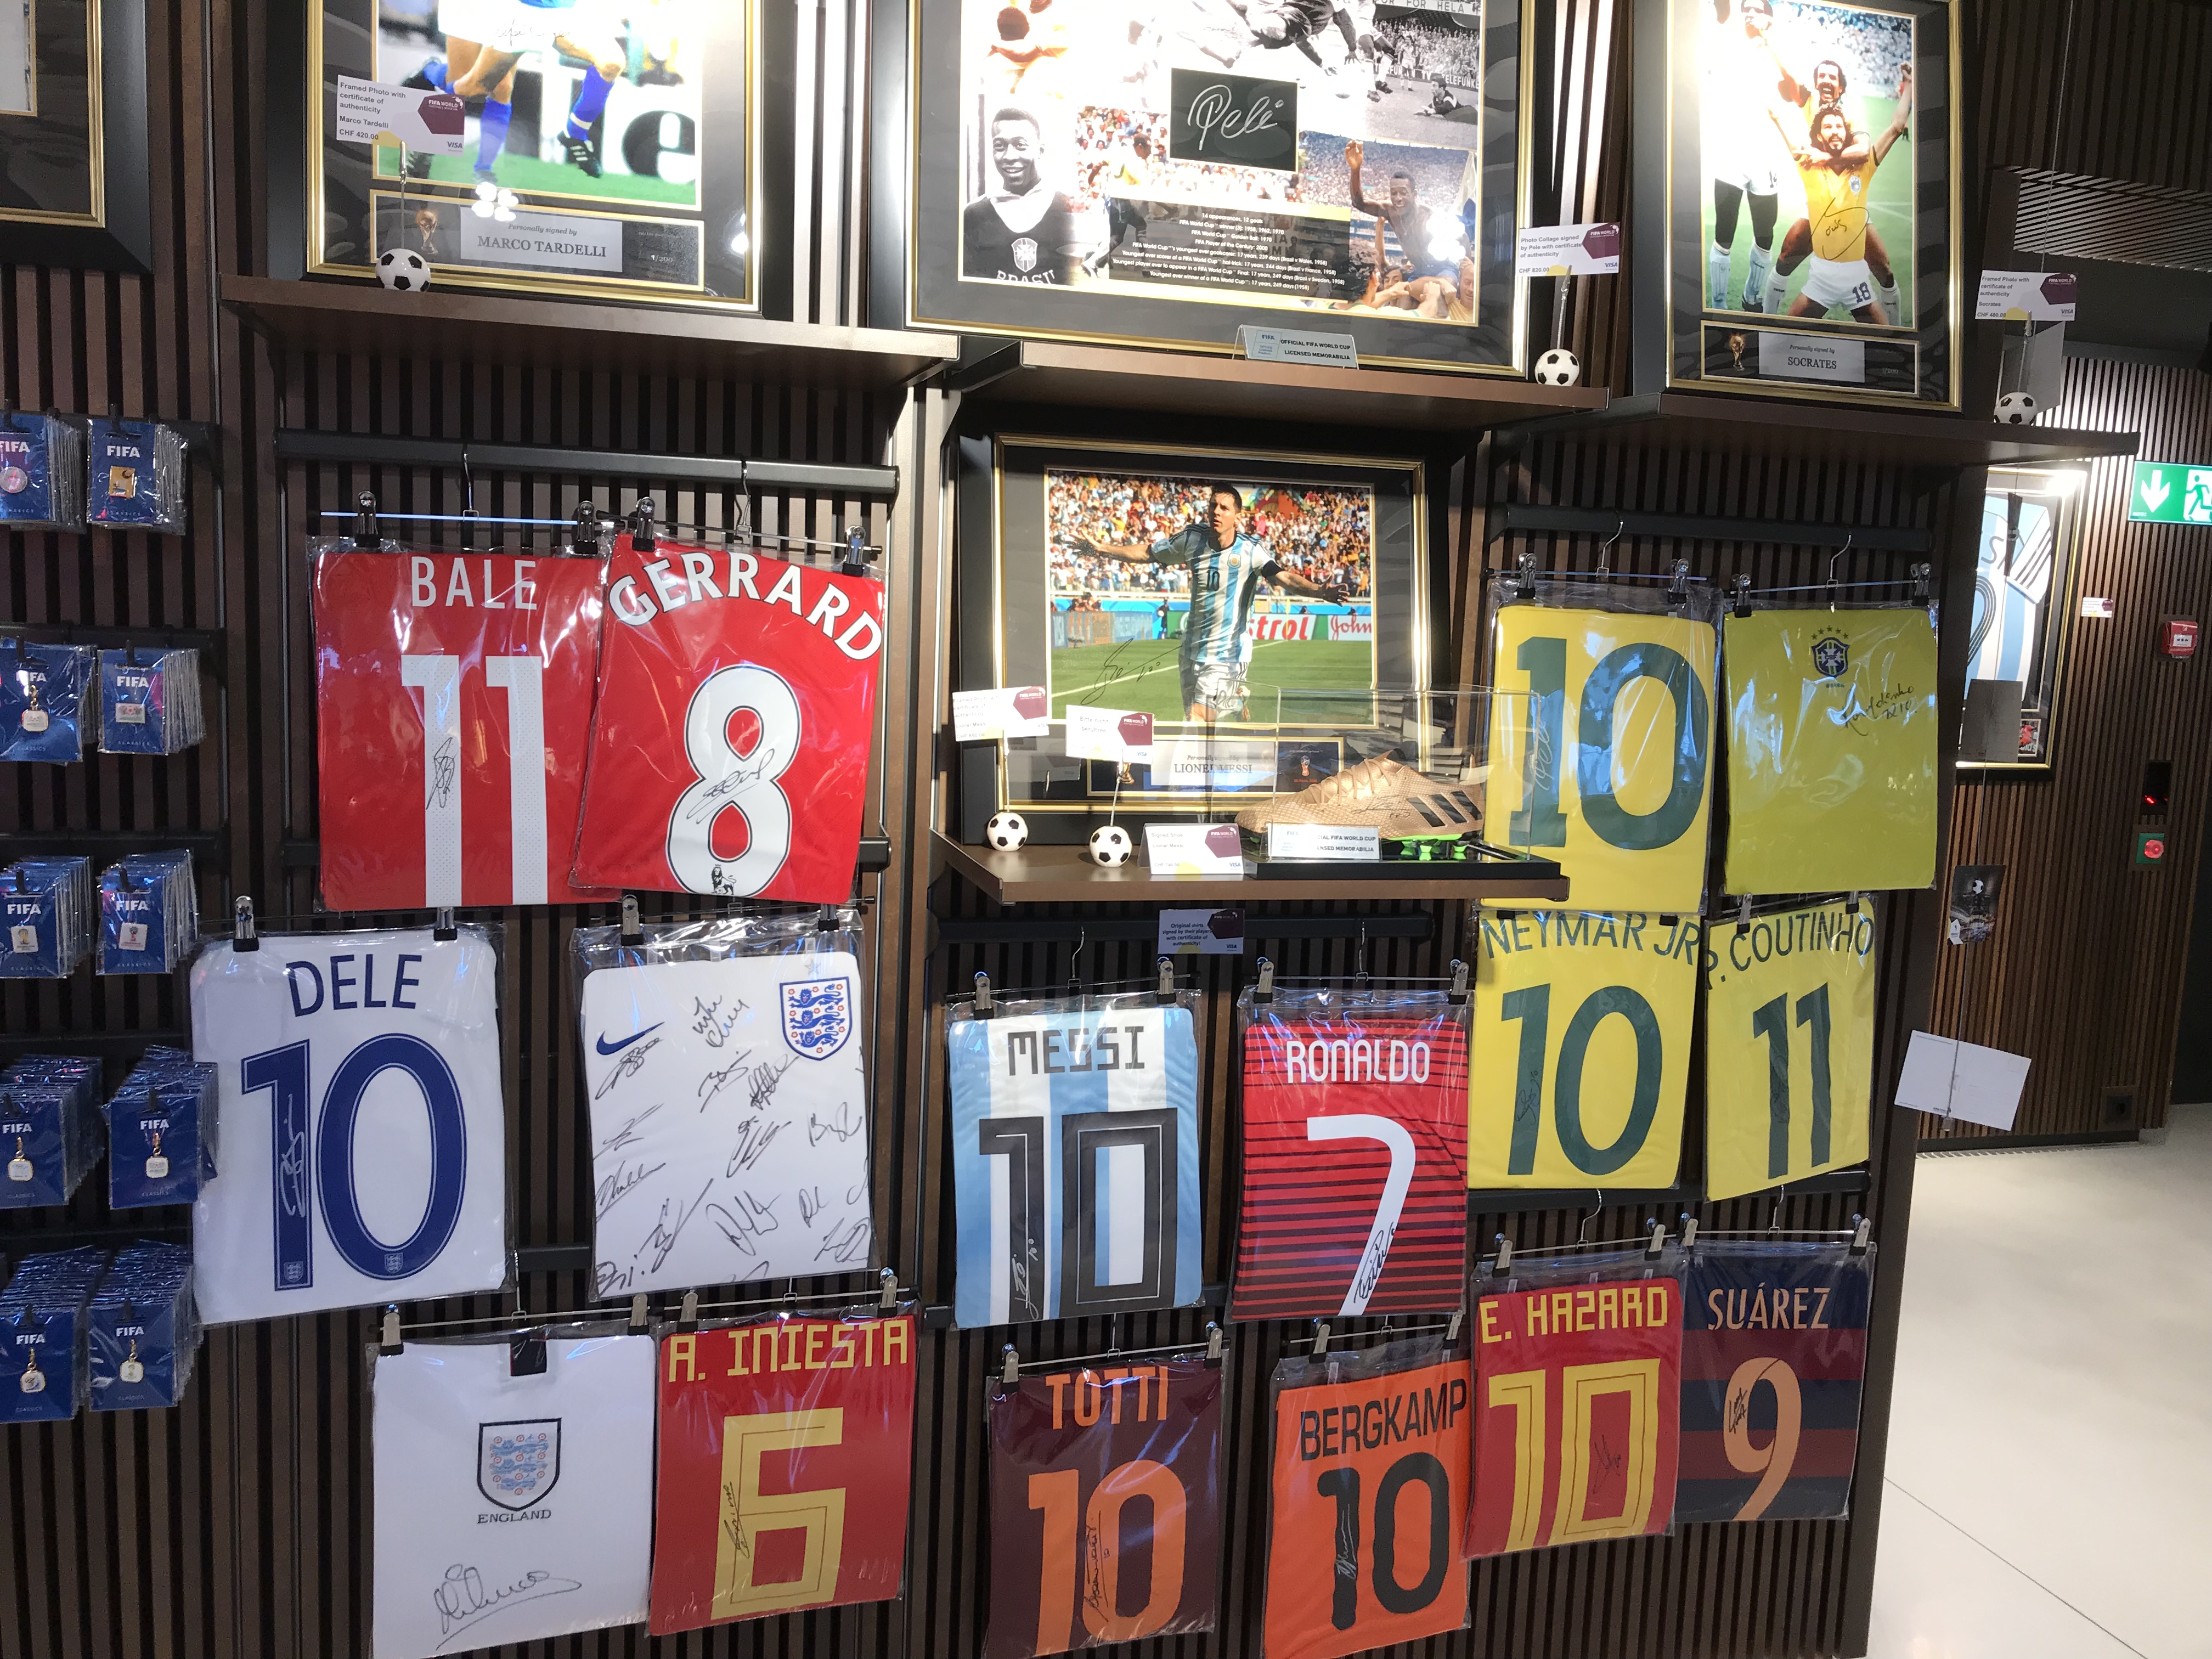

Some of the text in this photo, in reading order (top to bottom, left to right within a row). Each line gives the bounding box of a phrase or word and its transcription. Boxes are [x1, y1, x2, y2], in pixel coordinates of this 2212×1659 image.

[1407, 0, 1464, 13] FOR HELA
[340, 82, 366, 92] Framed
[369, 87, 390, 95] Photo
[340, 93, 374, 103] certificate
[1422, 71, 1432, 80] TV
[340, 103, 381, 114] authenticity
[340, 116, 388, 128] Marco Tardelli
[478, 236, 606, 257] MARCO TARDELLI
[508, 223, 544, 233] Personally
[546, 227, 567, 235] signed
[1852, 281, 1871, 303] 18
[1787, 357, 1837, 369] SOCRATES
[107, 445, 140, 458] FIFA
[411, 556, 538, 611] BALE
[1206, 569, 1220, 591] 10
[608, 551, 882, 661] GERRARD
[117, 676, 149, 687] FIFA
[1509, 636, 1709, 850] 10
[400, 654, 548, 908] 11
[665, 664, 802, 898] 8
[1174, 764, 1253, 774] LIONEL MESSI
[7, 904, 41, 915] FIFA
[116, 900, 150, 911] FIFA
[1481, 911, 1701, 966] NEYMAR JR
[1730, 911, 1874, 971] COUTINHO
[285, 954, 422, 1017] DELE
[1007, 1026, 1145, 1076] MESSI
[1287, 1040, 1430, 1084] RONALDO
[1501, 983, 1663, 1175] 10
[1753, 982, 1831, 1180] 11
[2, 1124, 32, 1133] FIFA
[140, 1119, 170, 1130] FIFA
[241, 1032, 467, 1291] 10
[979, 1107, 1178, 1324] 10
[1307, 1114, 1416, 1317] 7
[1480, 1286, 1668, 1344] E. HAZARD
[1708, 1282, 1831, 1330] SUÁREZ
[16, 1334, 47, 1345] FIFA
[116, 1326, 145, 1336] FIFA
[669, 1319, 907, 1382] A. INIESTA
[1046, 1365, 1169, 1429] TOTTI
[1300, 1378, 1467, 1462] BERGKAMP
[1488, 1358, 1661, 1553] 10
[1723, 1357, 1802, 1521] 9
[477, 1509, 551, 1524] ENGLAND
[710, 1407, 847, 1620] 6
[1028, 1459, 1187, 1657] 10
[1317, 1452, 1449, 1630] 10
